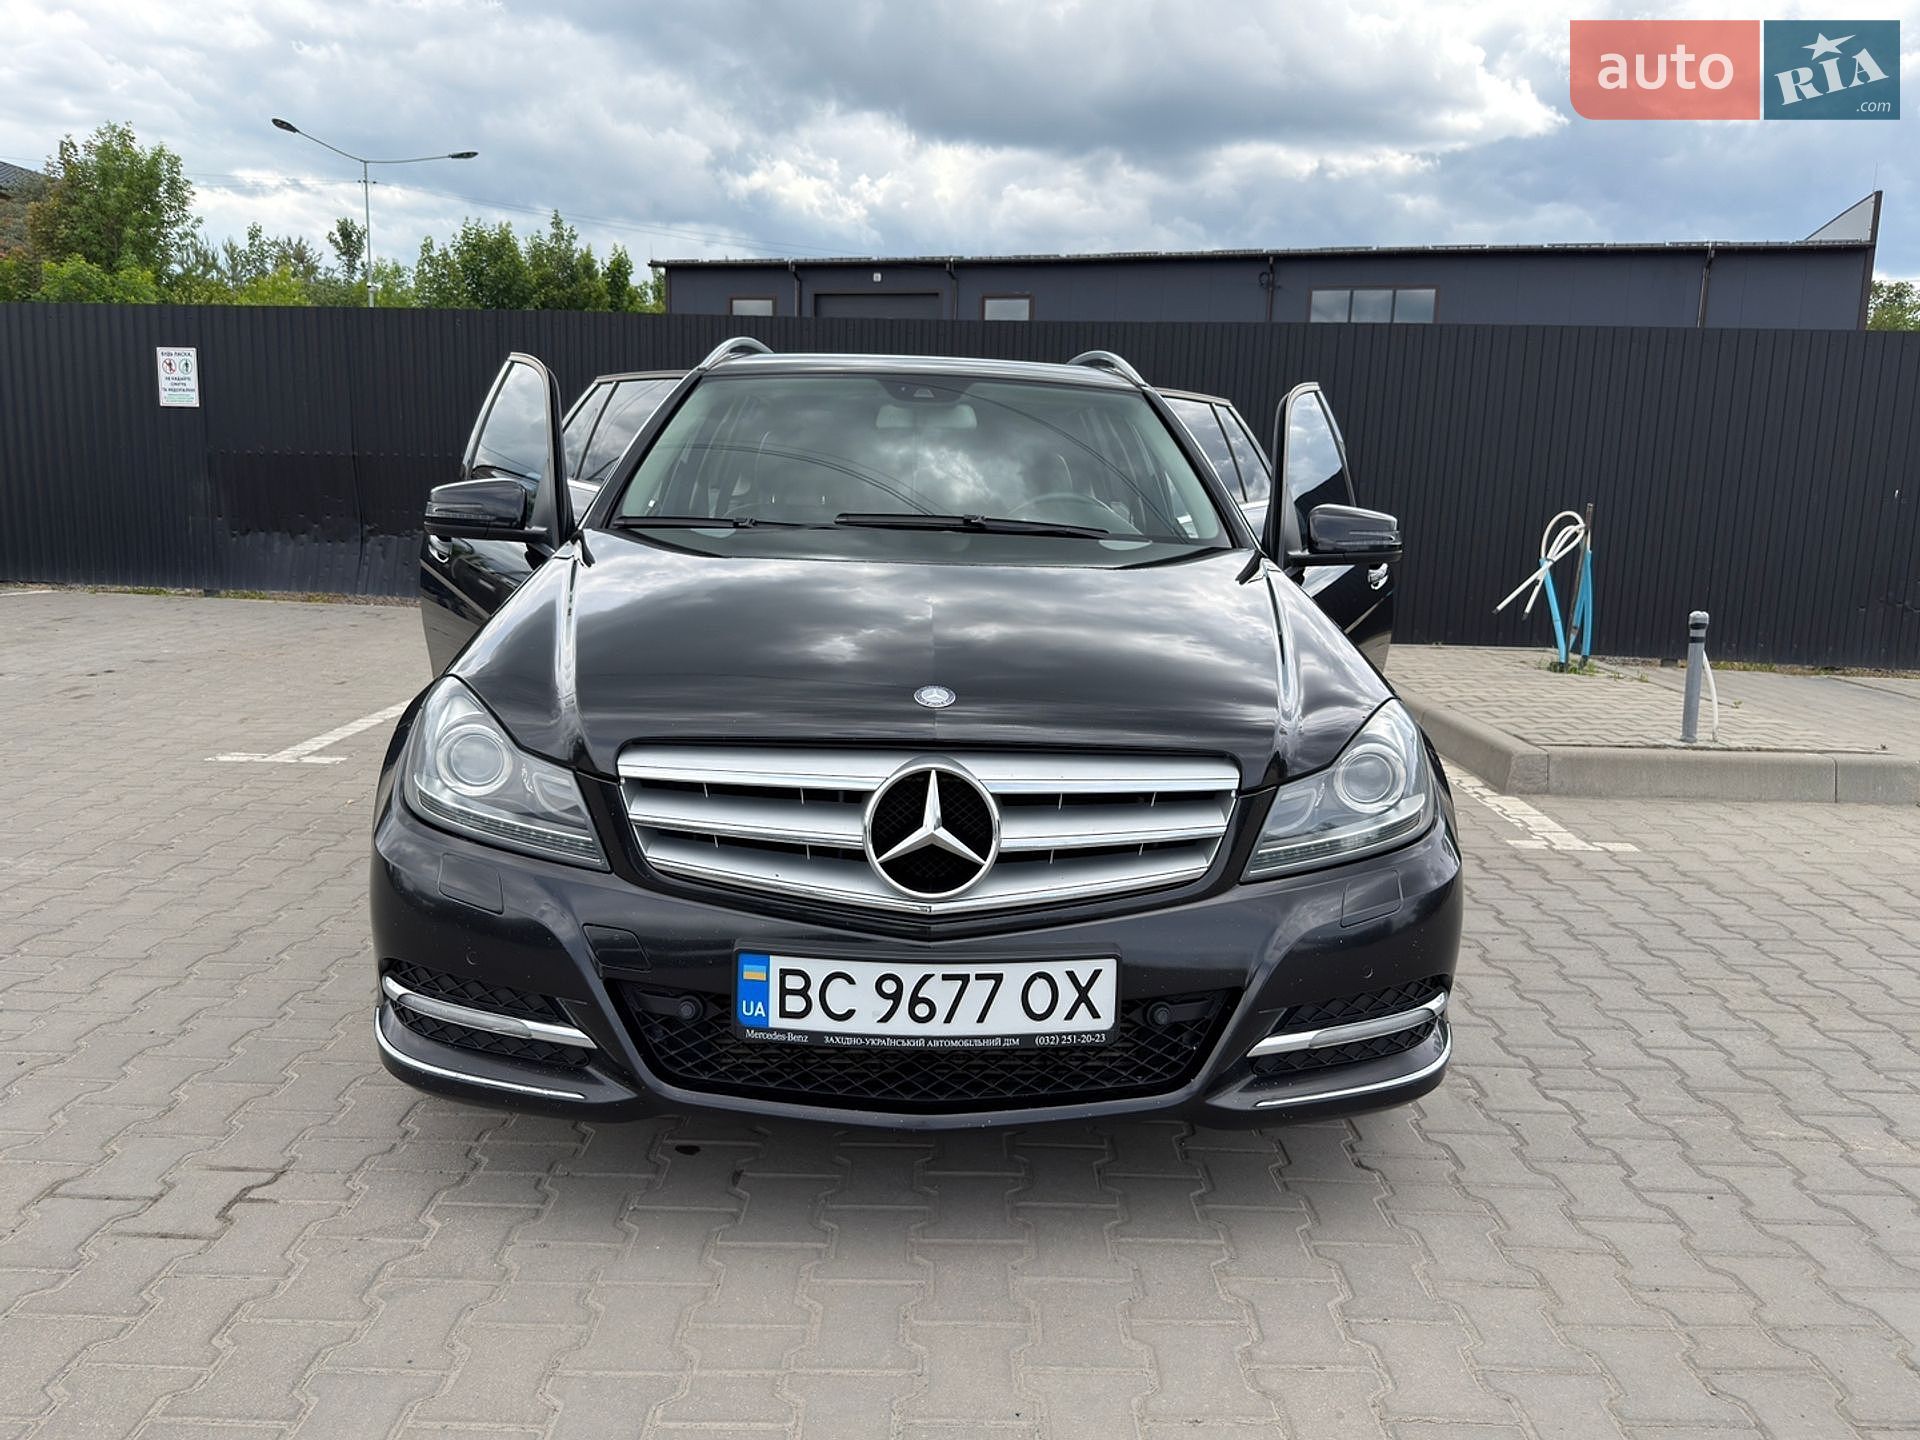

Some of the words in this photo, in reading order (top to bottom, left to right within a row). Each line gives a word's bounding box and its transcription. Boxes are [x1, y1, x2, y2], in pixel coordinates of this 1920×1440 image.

[778, 967, 857, 1021] BC
[874, 972, 1004, 1024] 9677
[1021, 967, 1104, 1021] OX
[742, 999, 767, 1018] UA
[745, 1028, 809, 1043] Mercedes-Benz
[823, 1035, 926, 1048] ЗАХІДНО-УКРАЇНСЬКИЙ
[1034, 1034, 1060, 1046] (032)
[1061, 1033, 1107, 1045] 251-20-23
